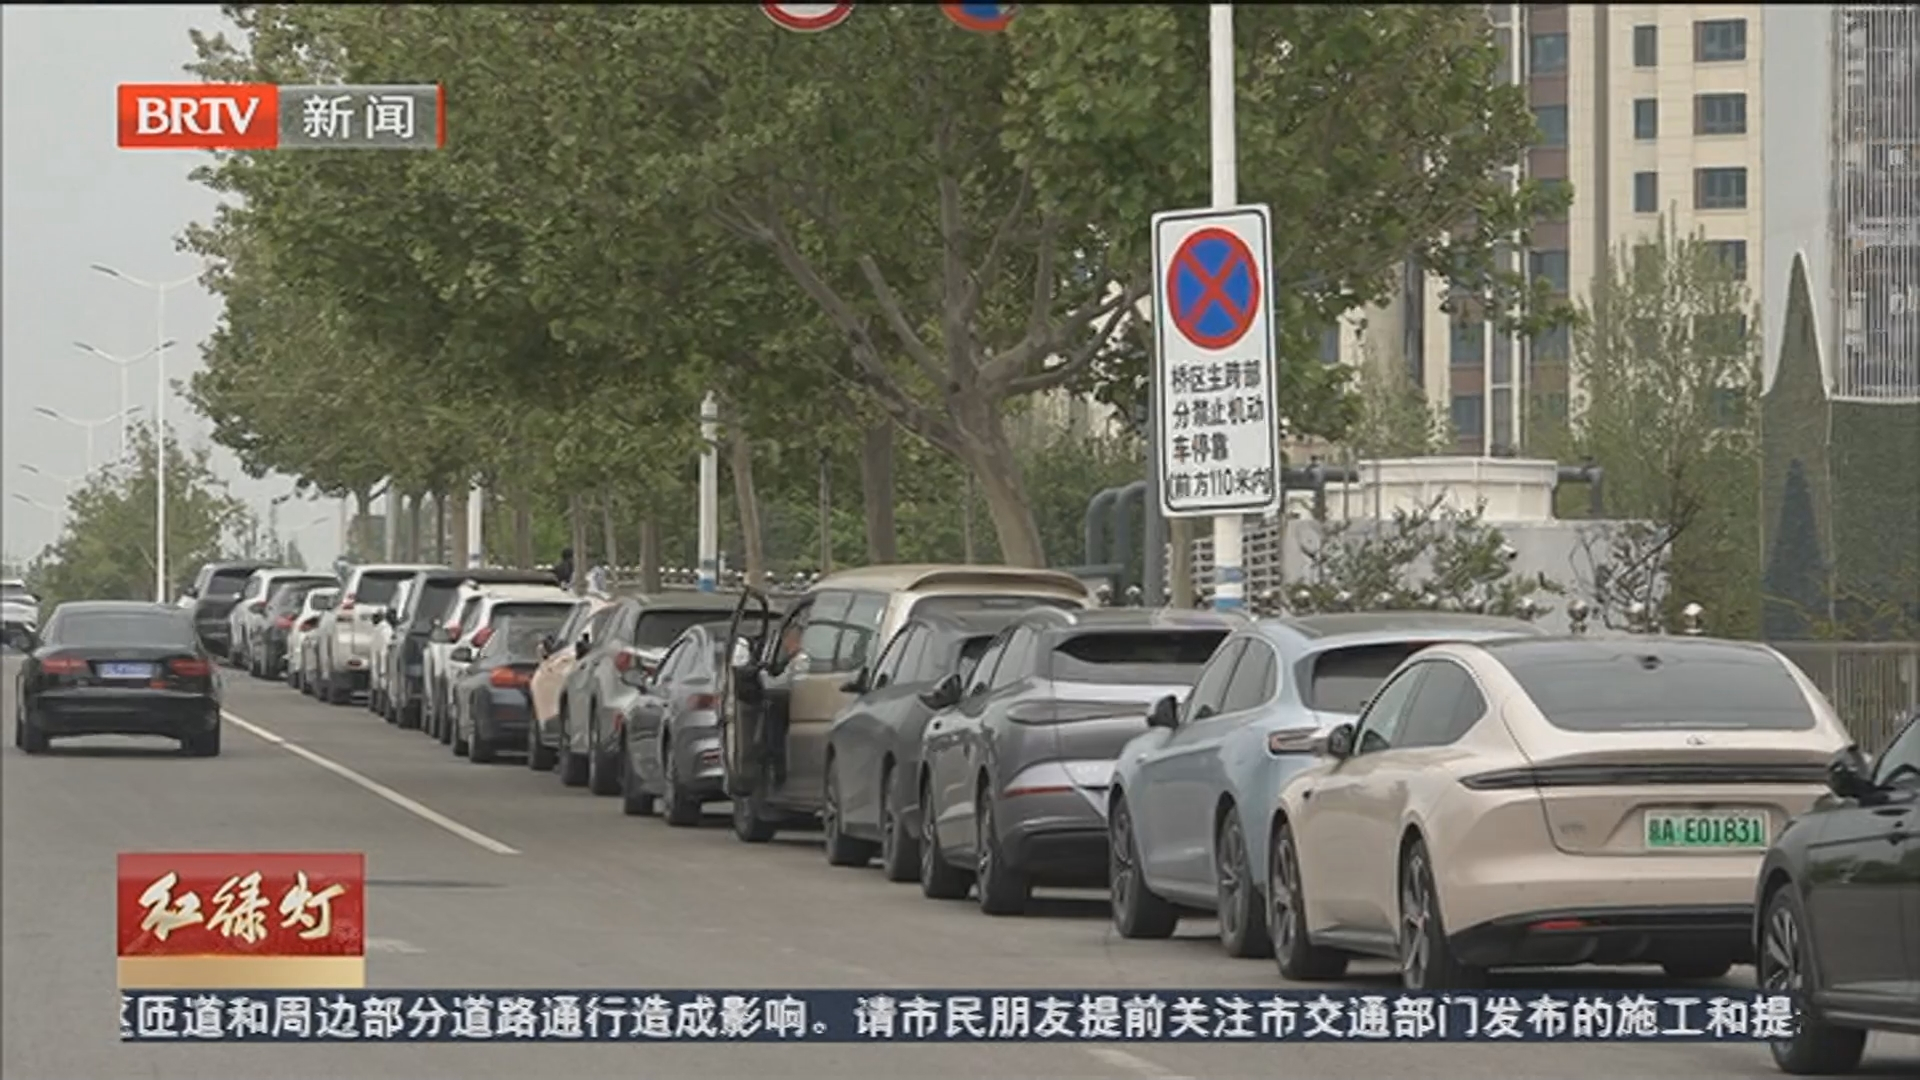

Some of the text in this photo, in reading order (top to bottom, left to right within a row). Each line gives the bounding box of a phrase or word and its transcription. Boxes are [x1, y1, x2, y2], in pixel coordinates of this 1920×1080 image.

[1173, 395, 1265, 429] 分禁止机动
[1173, 432, 1229, 465] 车停靠
